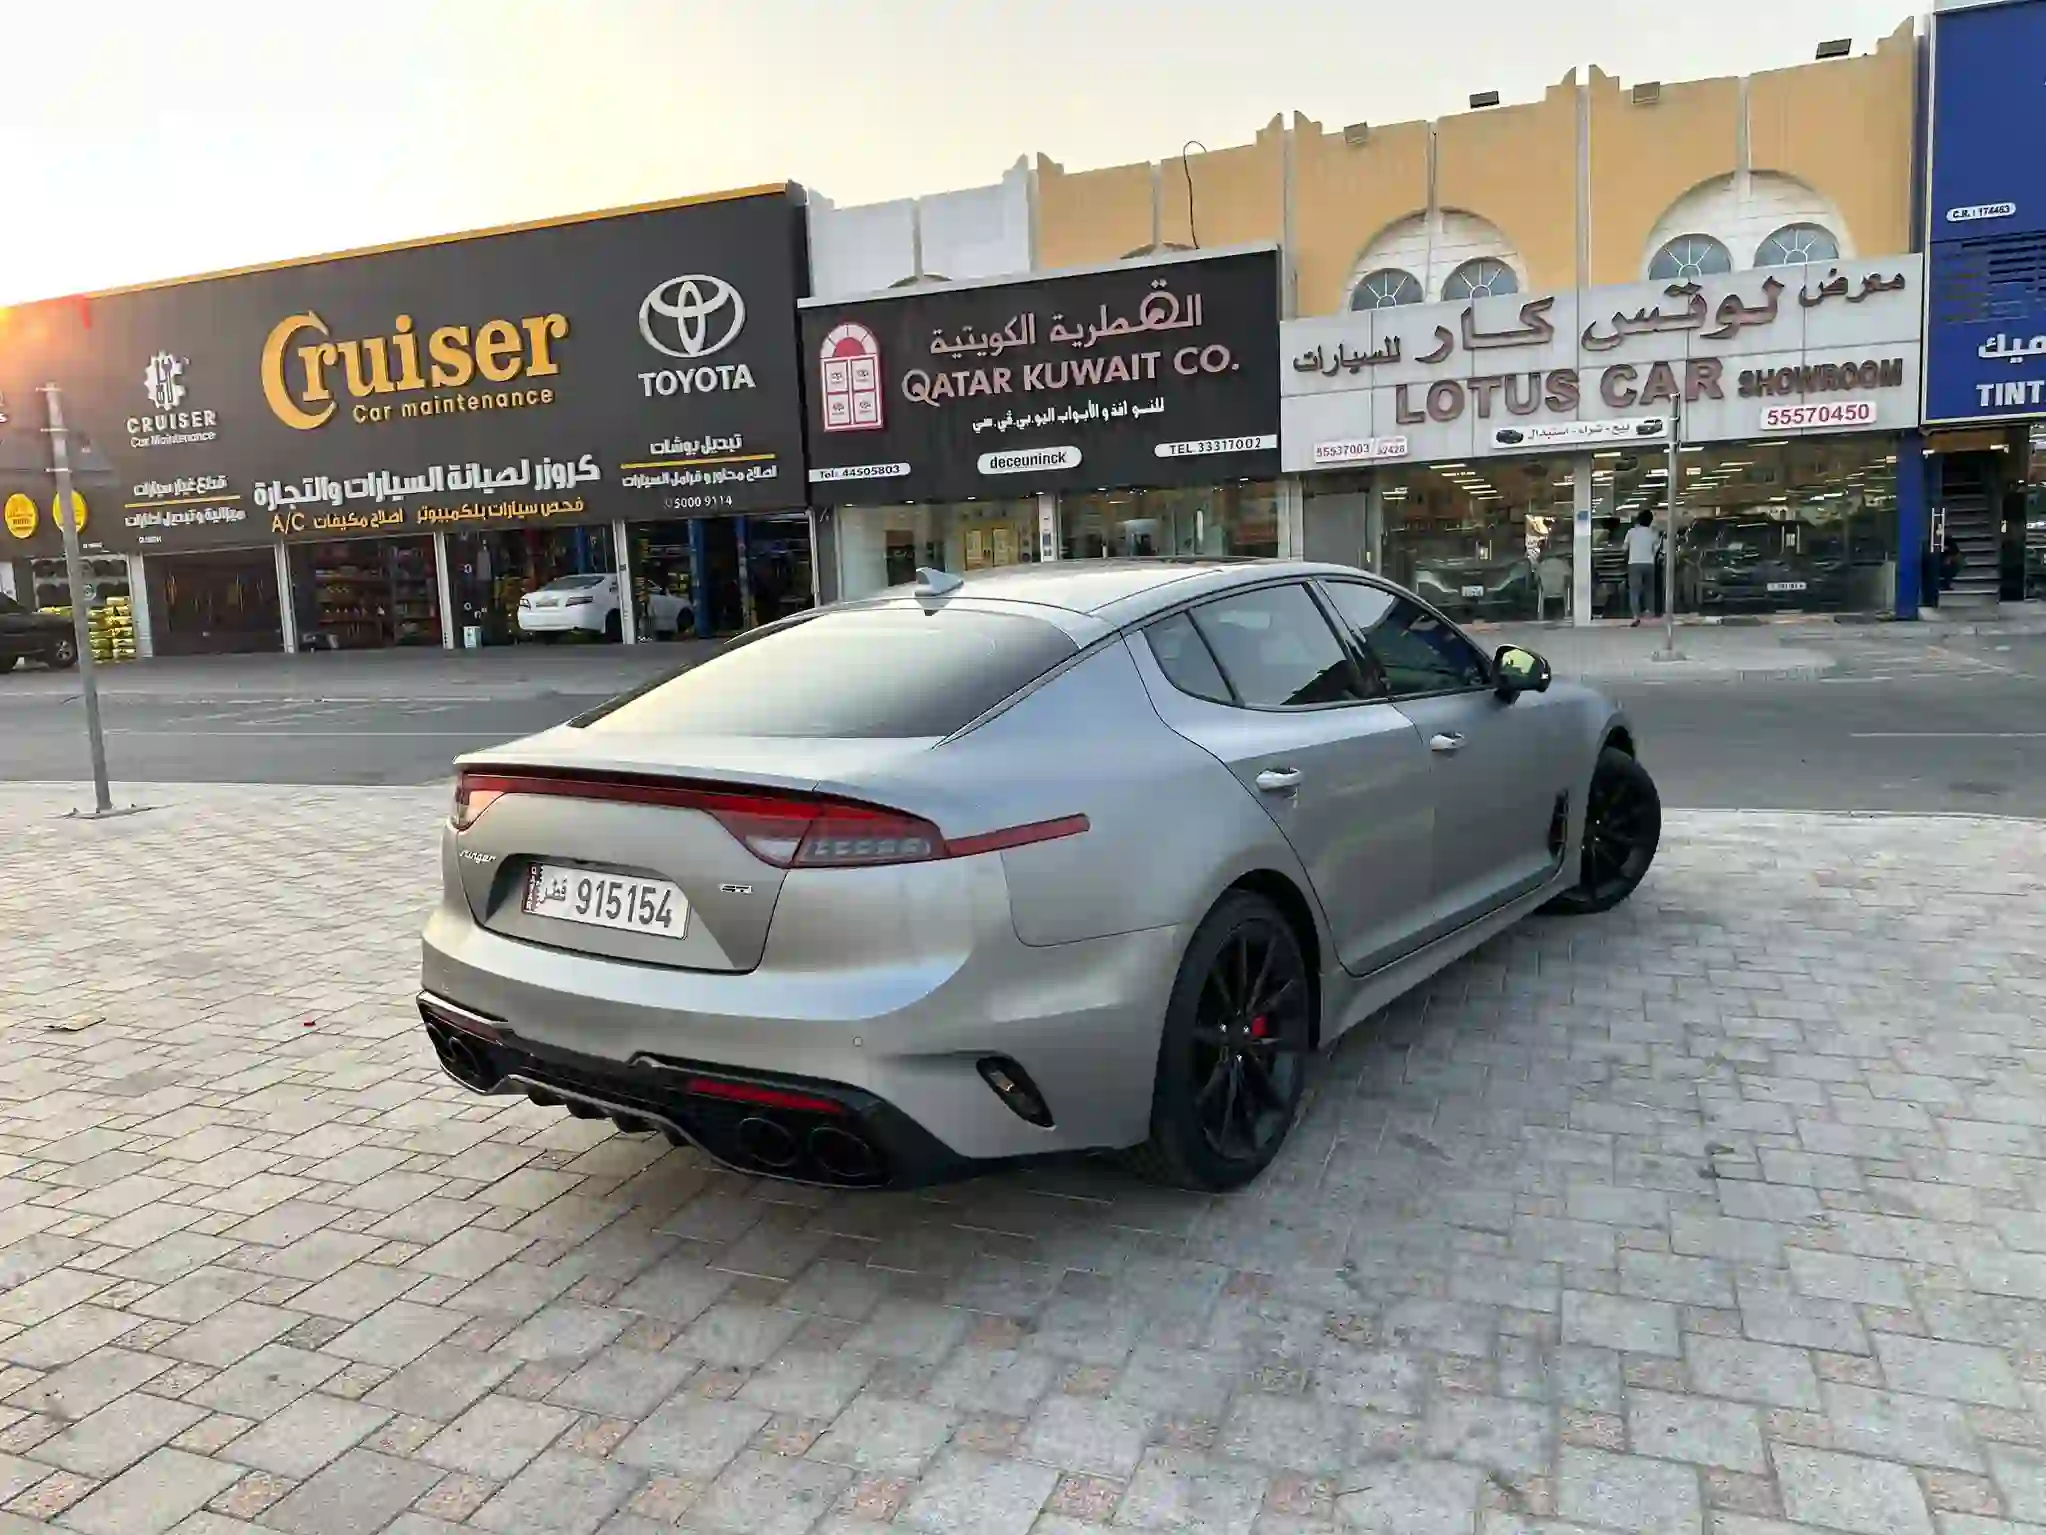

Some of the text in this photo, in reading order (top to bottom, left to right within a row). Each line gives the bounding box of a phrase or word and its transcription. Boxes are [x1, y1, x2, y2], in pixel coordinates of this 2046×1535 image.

[1799, 267, 1906, 308] معرض
[930, 312, 1036, 360] الكويتية
[1414, 295, 1555, 364] كار
[260, 309, 570, 430] Cruiser
[1293, 335, 1401, 376] للسيارات
[638, 362, 756, 396] TOYOTA
[901, 344, 1240, 406] QATAR KUWAIT CO.
[1394, 356, 1904, 425] LOTUS CAR SHOWROOM
[126, 409, 217, 434] CRUISER
[353, 386, 553, 424] Car maintenance
[1766, 403, 1870, 426] 55570450
[990, 451, 1067, 470] deceuninck
[1197, 437, 1261, 453] 33317002
[253, 454, 601, 512] كروزر لصيانة السيارات والتجارة
[842, 465, 900, 478] 44505803
[371, 507, 404, 528] اصلاح
[488, 500, 538, 519] سيارات
[541, 497, 584, 517] فحص
[674, 496, 701, 509] 5000
[271, 511, 306, 535] A/C
[575, 878, 673, 928] 915154
